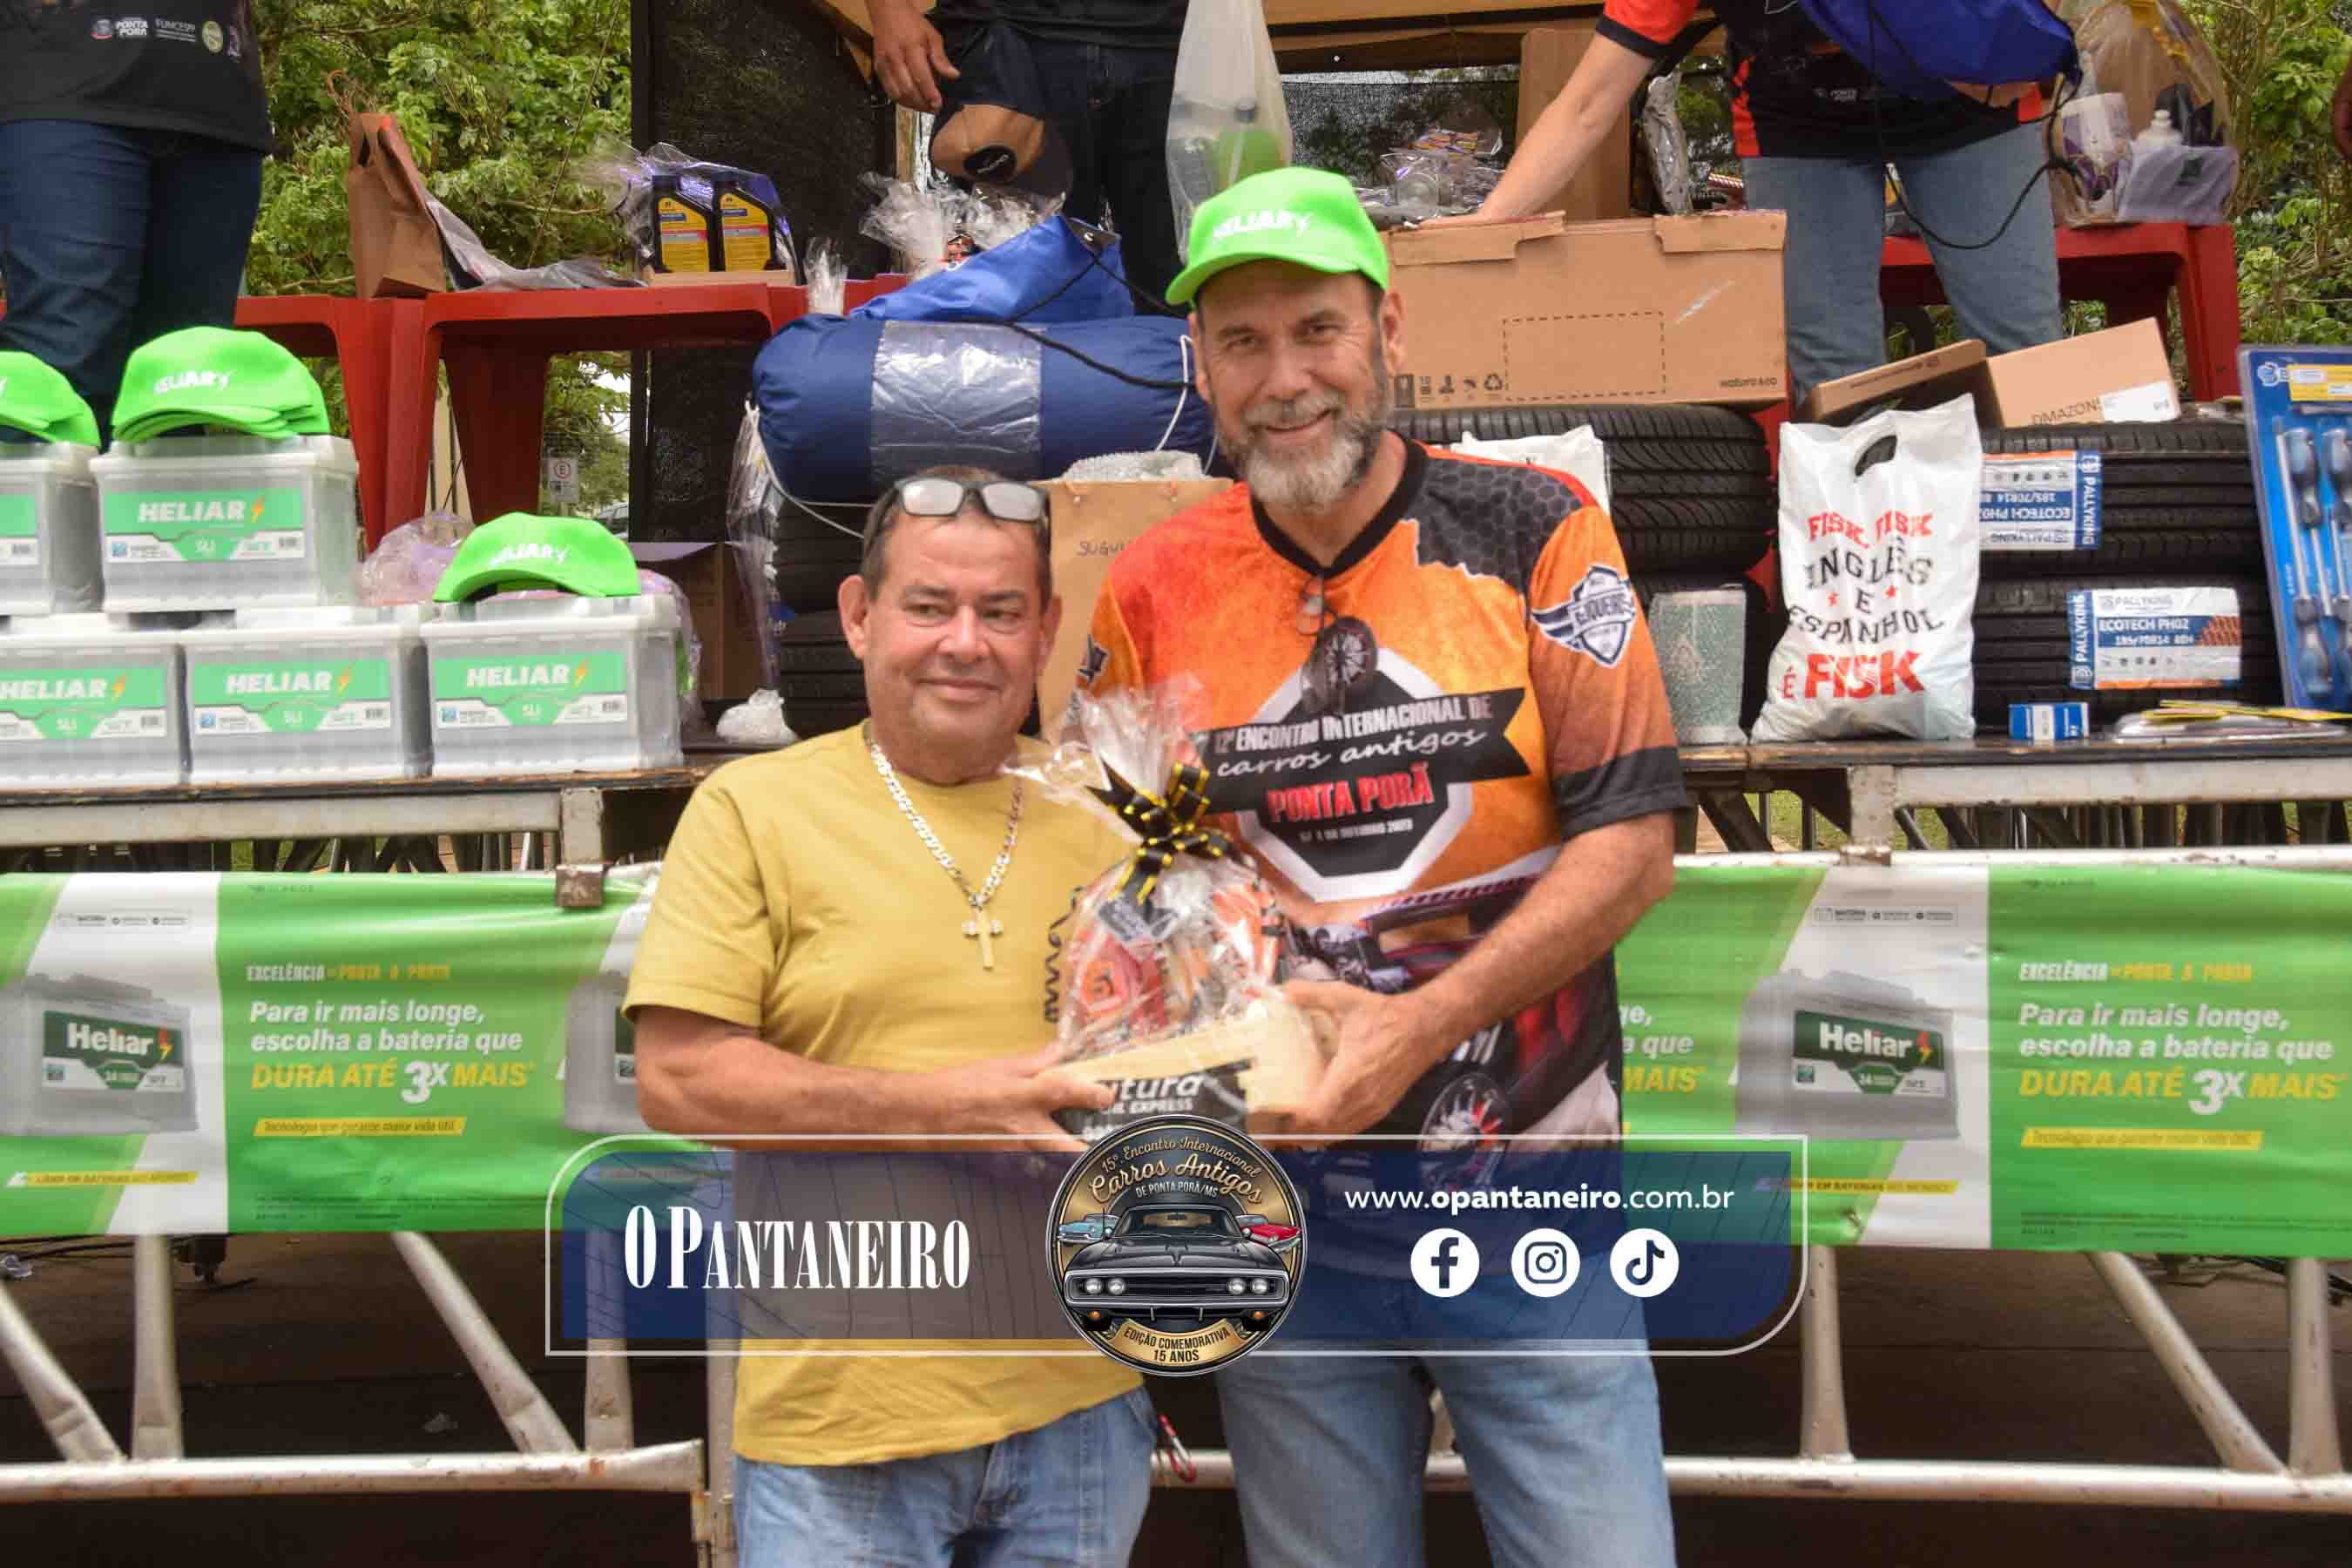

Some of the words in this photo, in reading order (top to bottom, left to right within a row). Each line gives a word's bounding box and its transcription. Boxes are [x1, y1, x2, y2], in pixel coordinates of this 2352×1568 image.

[139, 501, 247, 524] HELIAR
[1807, 511, 1869, 548] FISK
[1876, 510, 1933, 541] FISK
[1804, 537, 1933, 590] INGLÊS
[1855, 588, 1875, 614] E
[1787, 604, 1945, 644] ESPANHOL
[2099, 618, 2156, 632] ECOTECH
[0, 679, 107, 700] HELIAR
[225, 671, 334, 694] HELIAR
[467, 665, 569, 687] HELIAR
[1783, 666, 1797, 699] É
[1804, 650, 1925, 700] FISK
[1321, 698, 1465, 740] INTERNACIONAL
[1468, 694, 1493, 719] DE
[1217, 749, 1331, 778] carros
[1340, 730, 1488, 764] antigos
[1267, 781, 1356, 822] PONTA
[1356, 762, 1435, 813] PORÃ
[250, 1001, 308, 1024] Para
[314, 999, 335, 1023] ir
[339, 999, 401, 1023] mais
[405, 999, 485, 1026] longe,
[2019, 1003, 2085, 1027] Para
[2092, 1001, 2113, 1027] ir
[2119, 1004, 2189, 1027] mais
[2196, 1004, 2289, 1032] longe,
[67, 1022, 154, 1056] Heliar
[250, 1029, 351, 1052] escolha
[357, 1033, 372, 1051] a
[377, 1030, 469, 1052] bateria
[475, 1032, 524, 1056] que
[1642, 1036, 1694, 1060] que
[1818, 1021, 1914, 1058] Heliar
[2019, 1033, 2133, 1058] escolha
[2139, 1040, 2156, 1058] a
[2163, 1033, 2268, 1059] bateria
[2276, 1039, 2335, 1065] que
[251, 1063, 335, 1088] DURA
[340, 1057, 398, 1088] ATÉ
[2019, 1070, 2113, 1098] DURA
[2119, 1066, 2185, 1098] ATÉ
